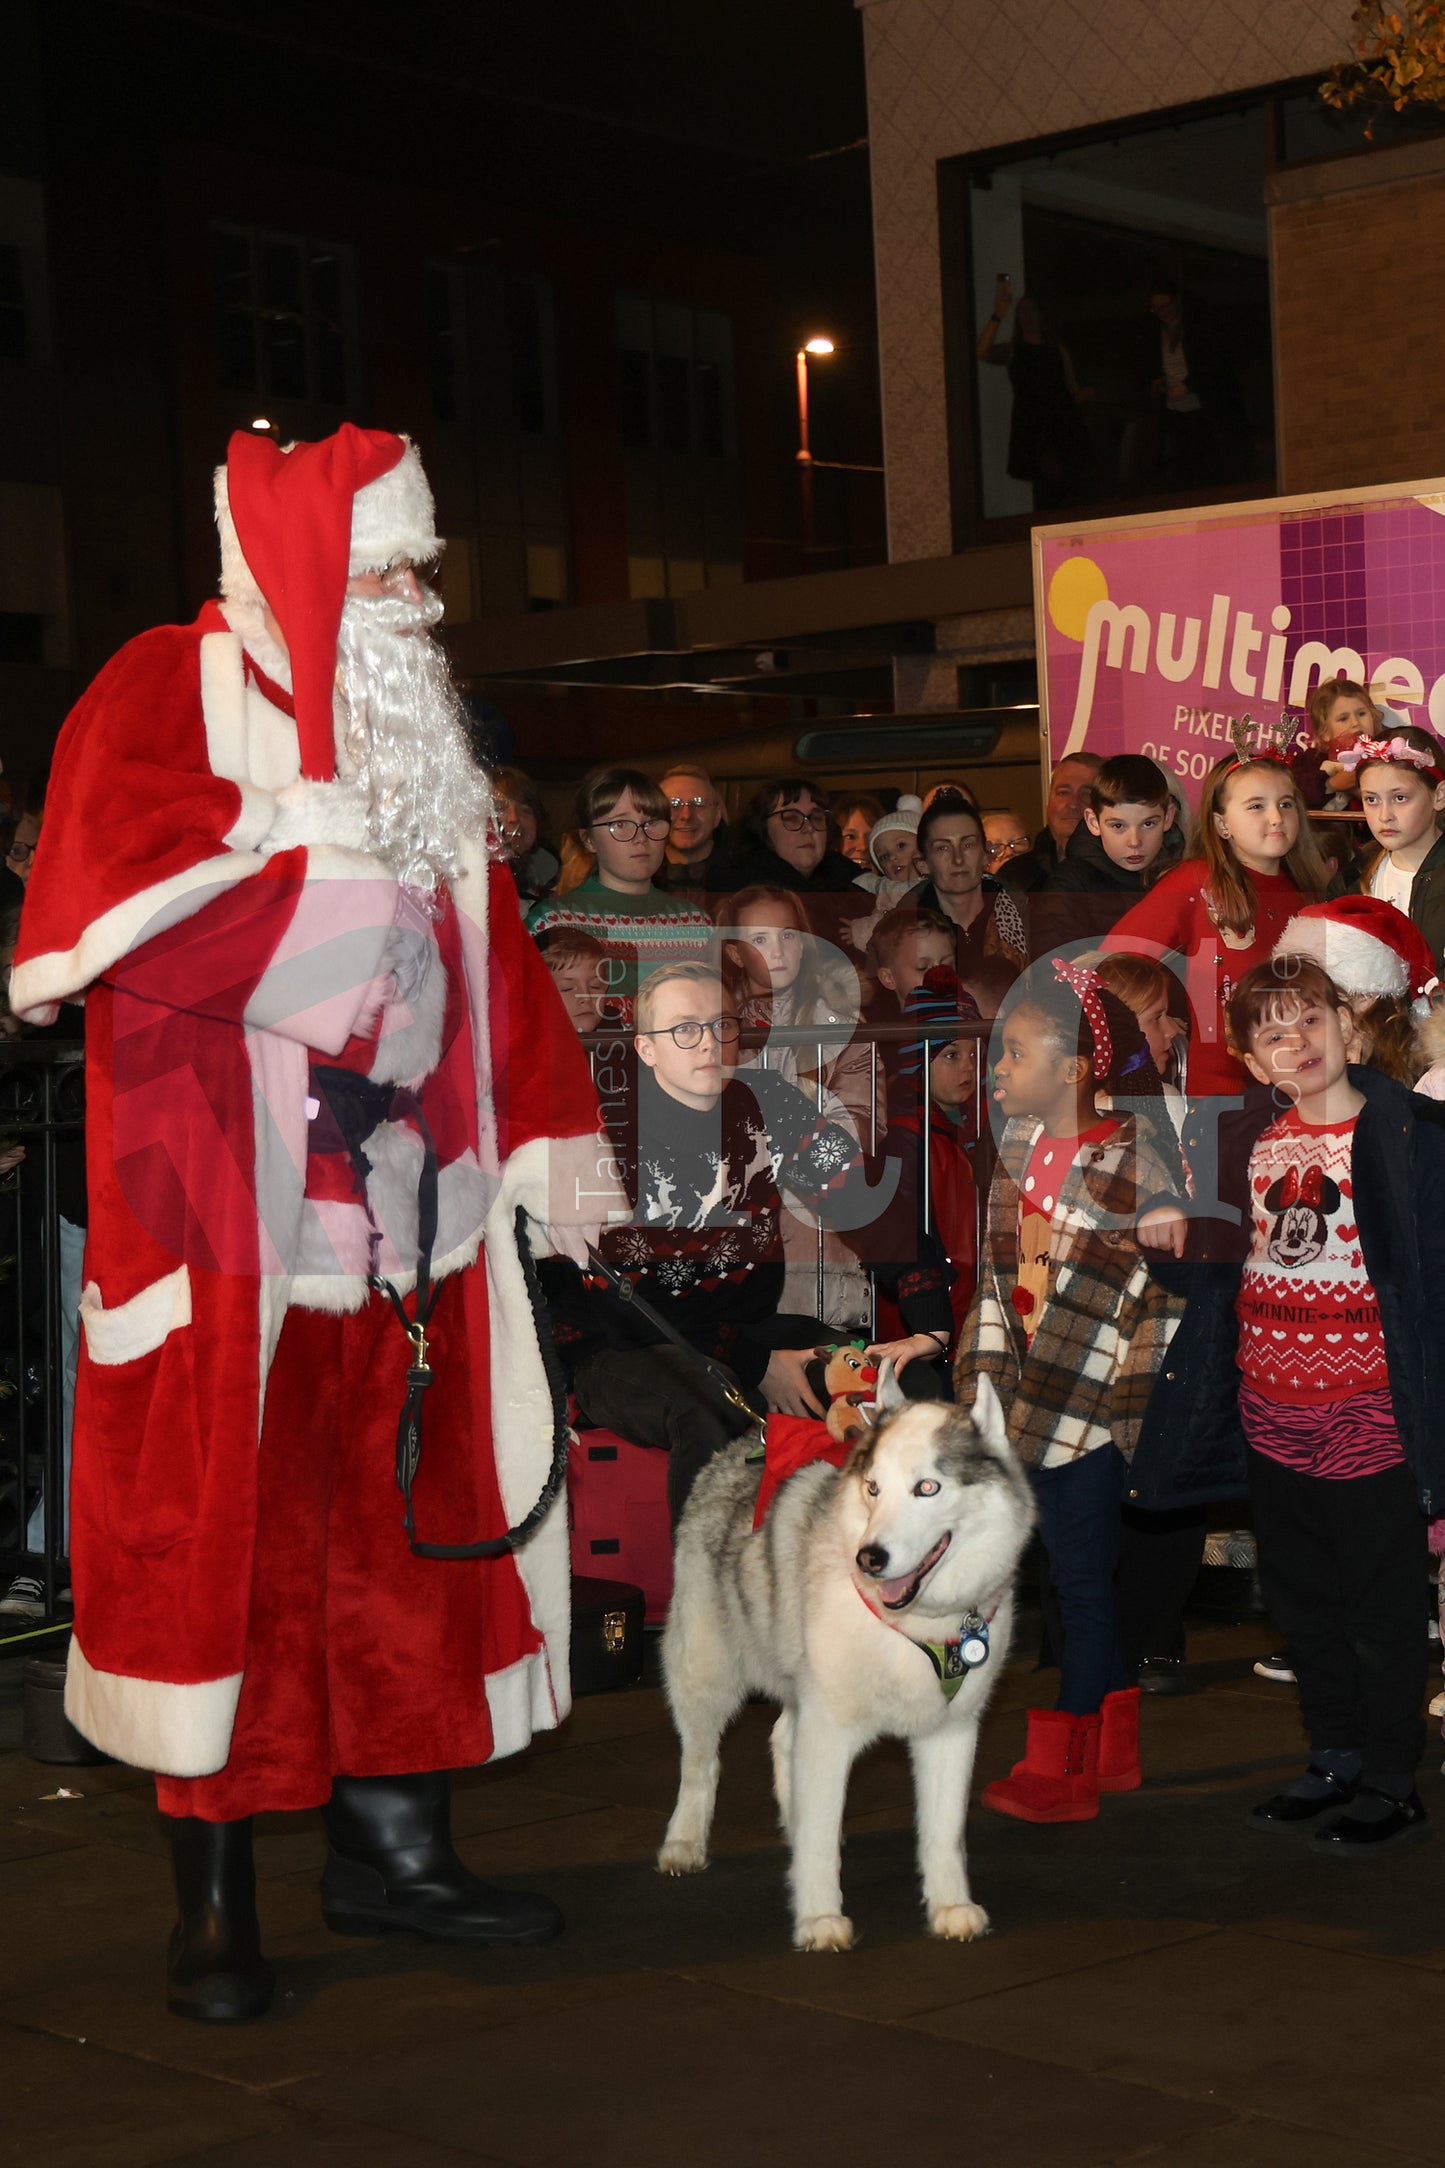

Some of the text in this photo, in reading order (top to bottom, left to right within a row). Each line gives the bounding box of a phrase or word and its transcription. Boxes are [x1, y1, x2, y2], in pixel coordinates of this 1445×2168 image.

[1061, 594, 1445, 761] multime
[1174, 704, 1235, 744] PIXEL
[1252, 1301, 1317, 1323] MINNIE
